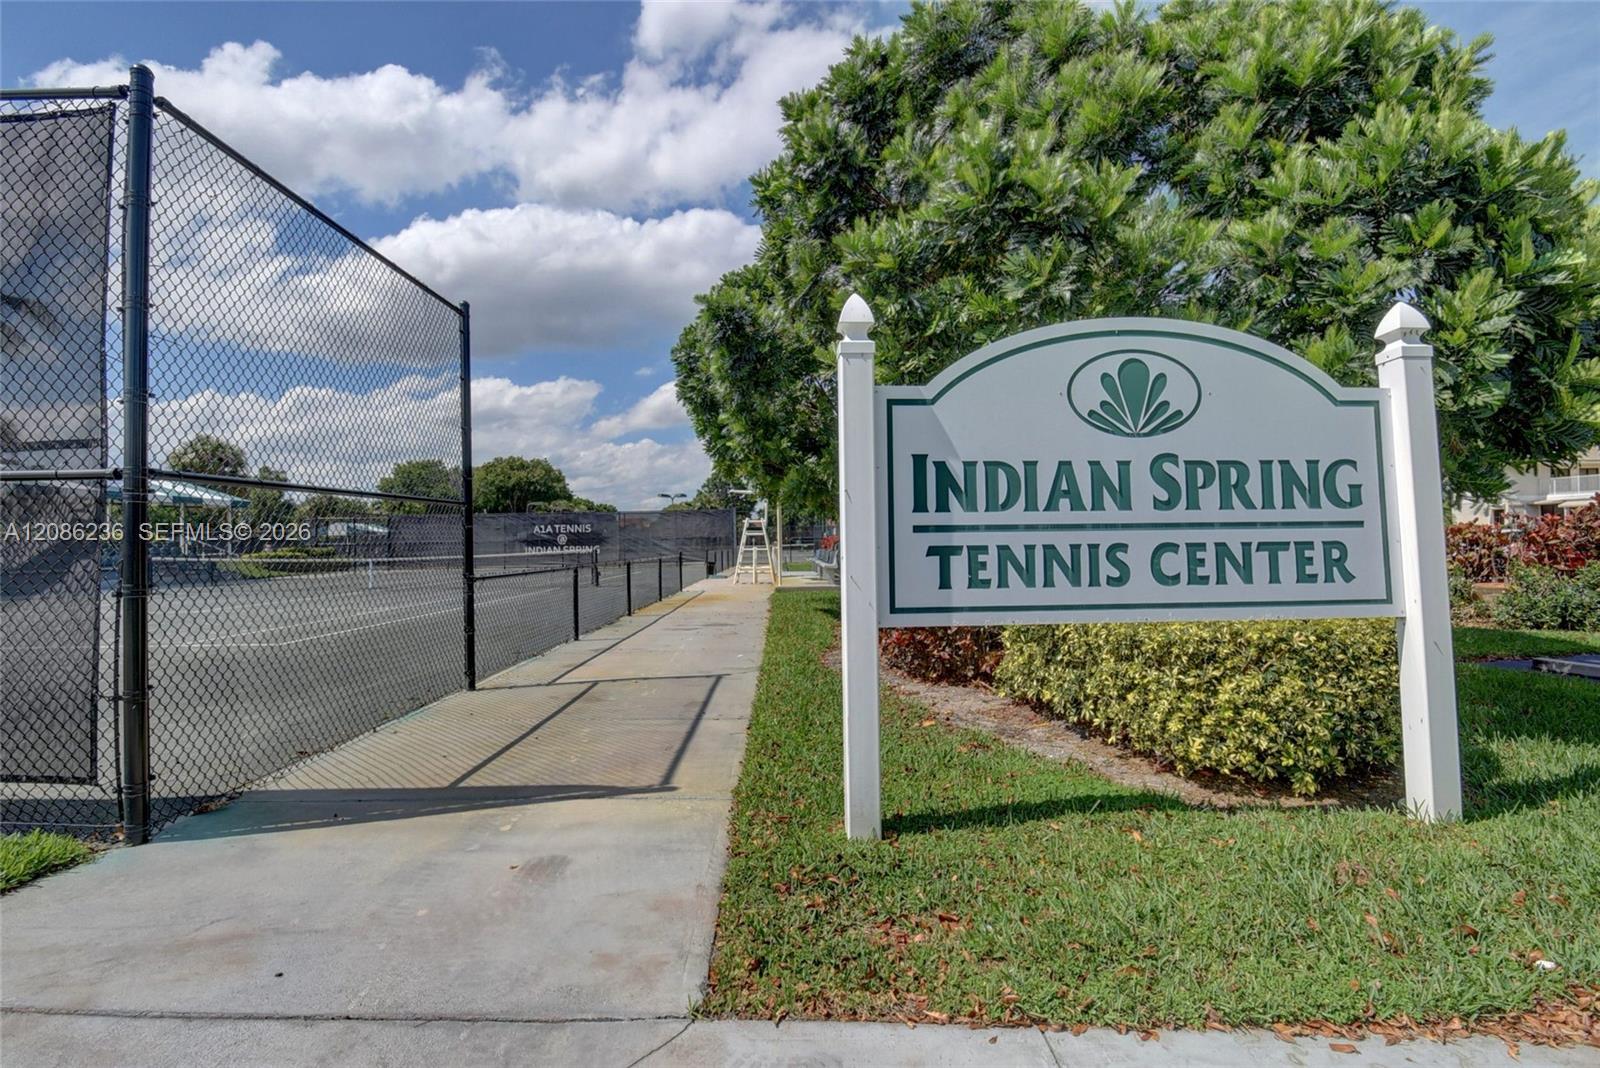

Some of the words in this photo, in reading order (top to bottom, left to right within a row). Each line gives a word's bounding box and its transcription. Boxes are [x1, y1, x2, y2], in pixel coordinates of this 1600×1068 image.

[911, 453, 1133, 513] INDIAN
[1149, 452, 1363, 512] SPRING
[533, 525, 553, 534] A1A
[554, 524, 592, 533] TENNIS
[925, 542, 1131, 590] TENNIS
[1150, 540, 1357, 587] CENTER
